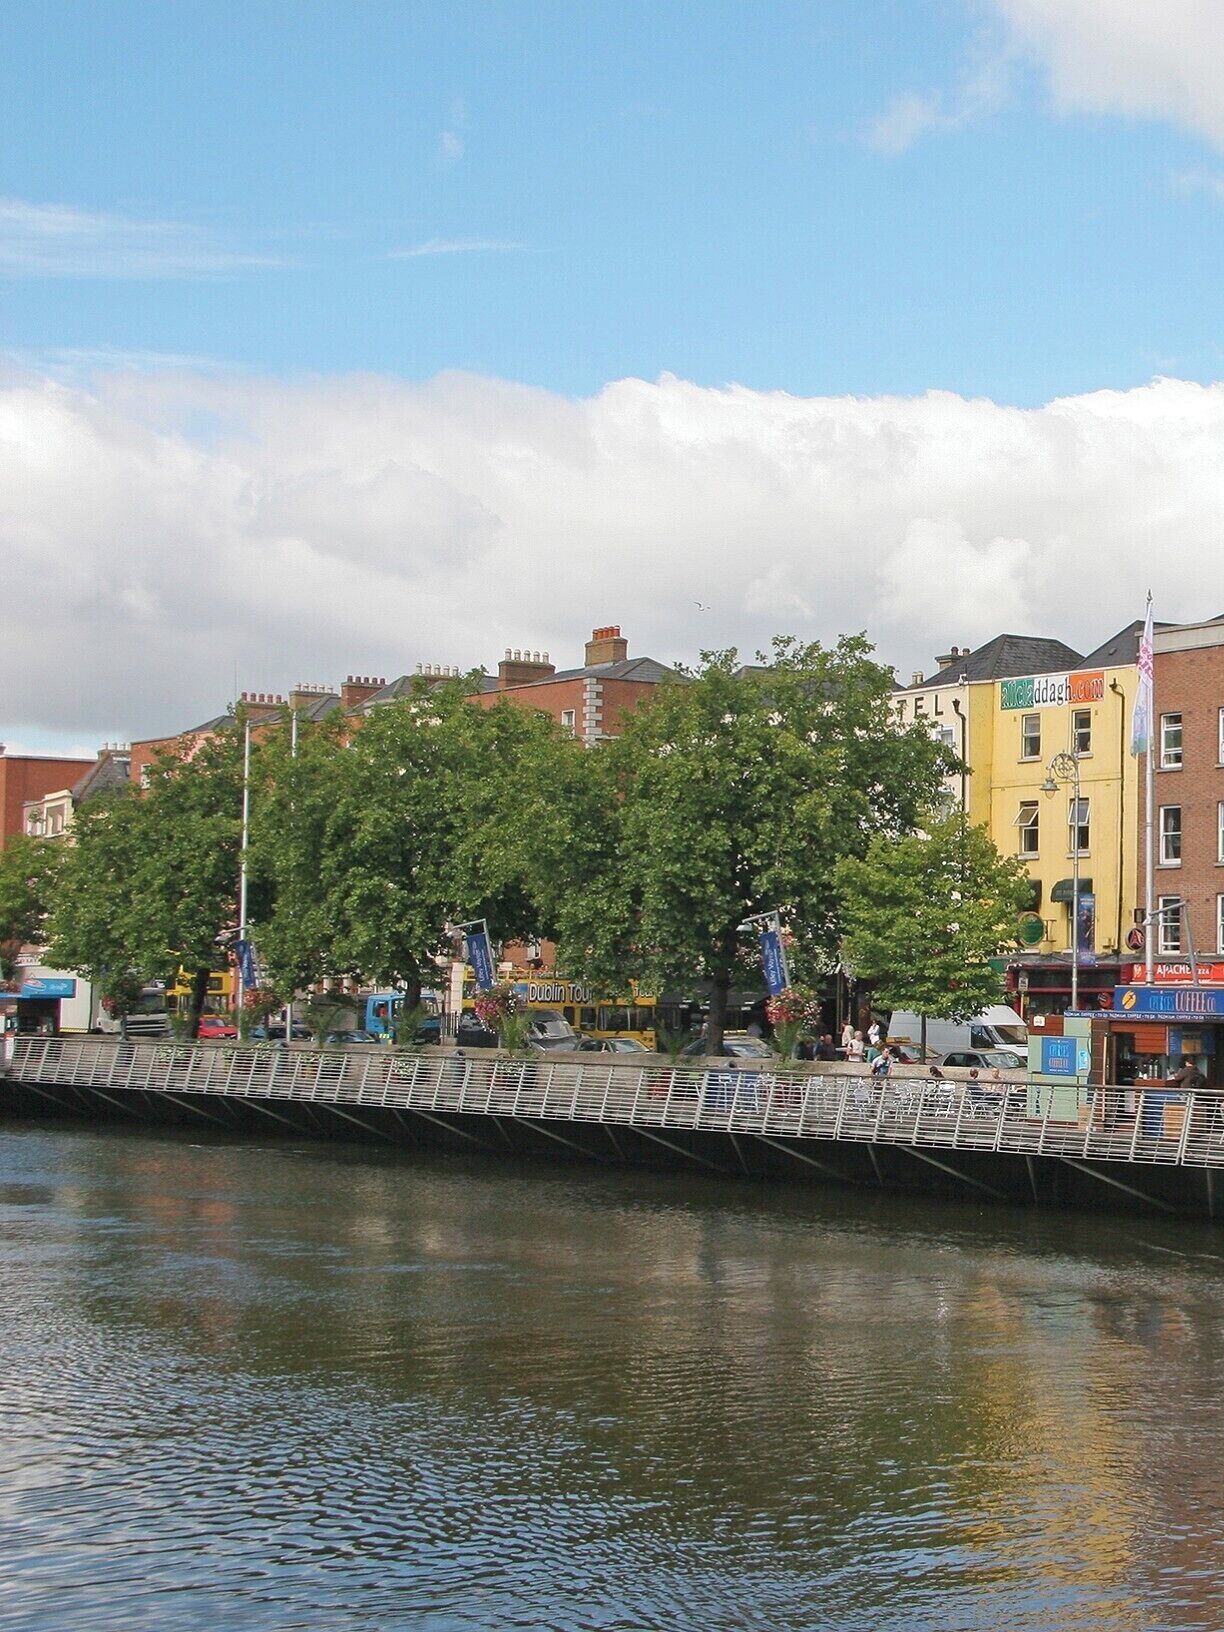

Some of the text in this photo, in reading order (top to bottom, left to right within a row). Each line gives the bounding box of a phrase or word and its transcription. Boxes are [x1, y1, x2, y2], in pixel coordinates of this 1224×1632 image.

[1001, 678, 1104, 708] allcladdagh.com
[1156, 964, 1192, 978] APACHE
[529, 983, 566, 1002] Dublin
[1175, 990, 1207, 1013] COFFEE
